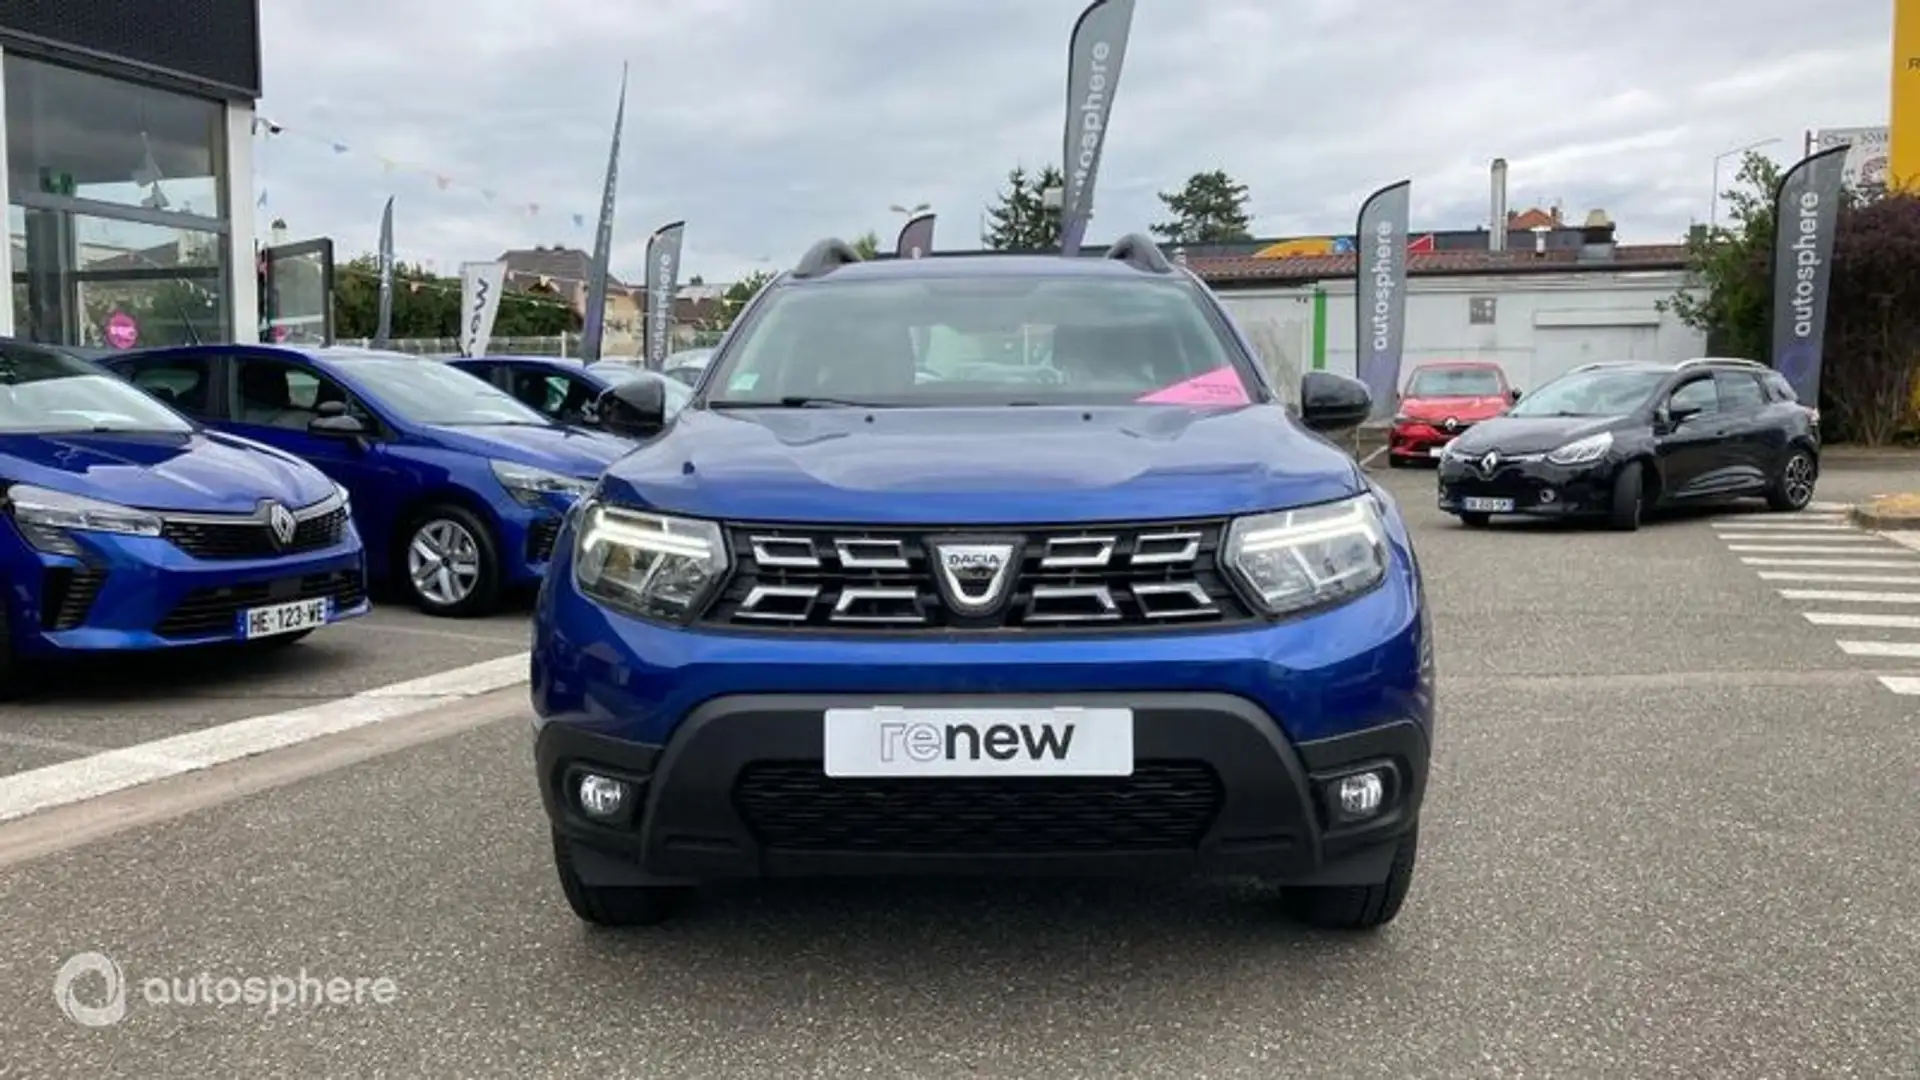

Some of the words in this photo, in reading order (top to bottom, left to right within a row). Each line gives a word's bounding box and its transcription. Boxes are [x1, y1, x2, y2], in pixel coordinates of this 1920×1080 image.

[1371, 220, 1395, 352] autosphere
[1792, 191, 1823, 338] autosphere
[948, 553, 1001, 566] DACIA
[880, 722, 1076, 763] renew
